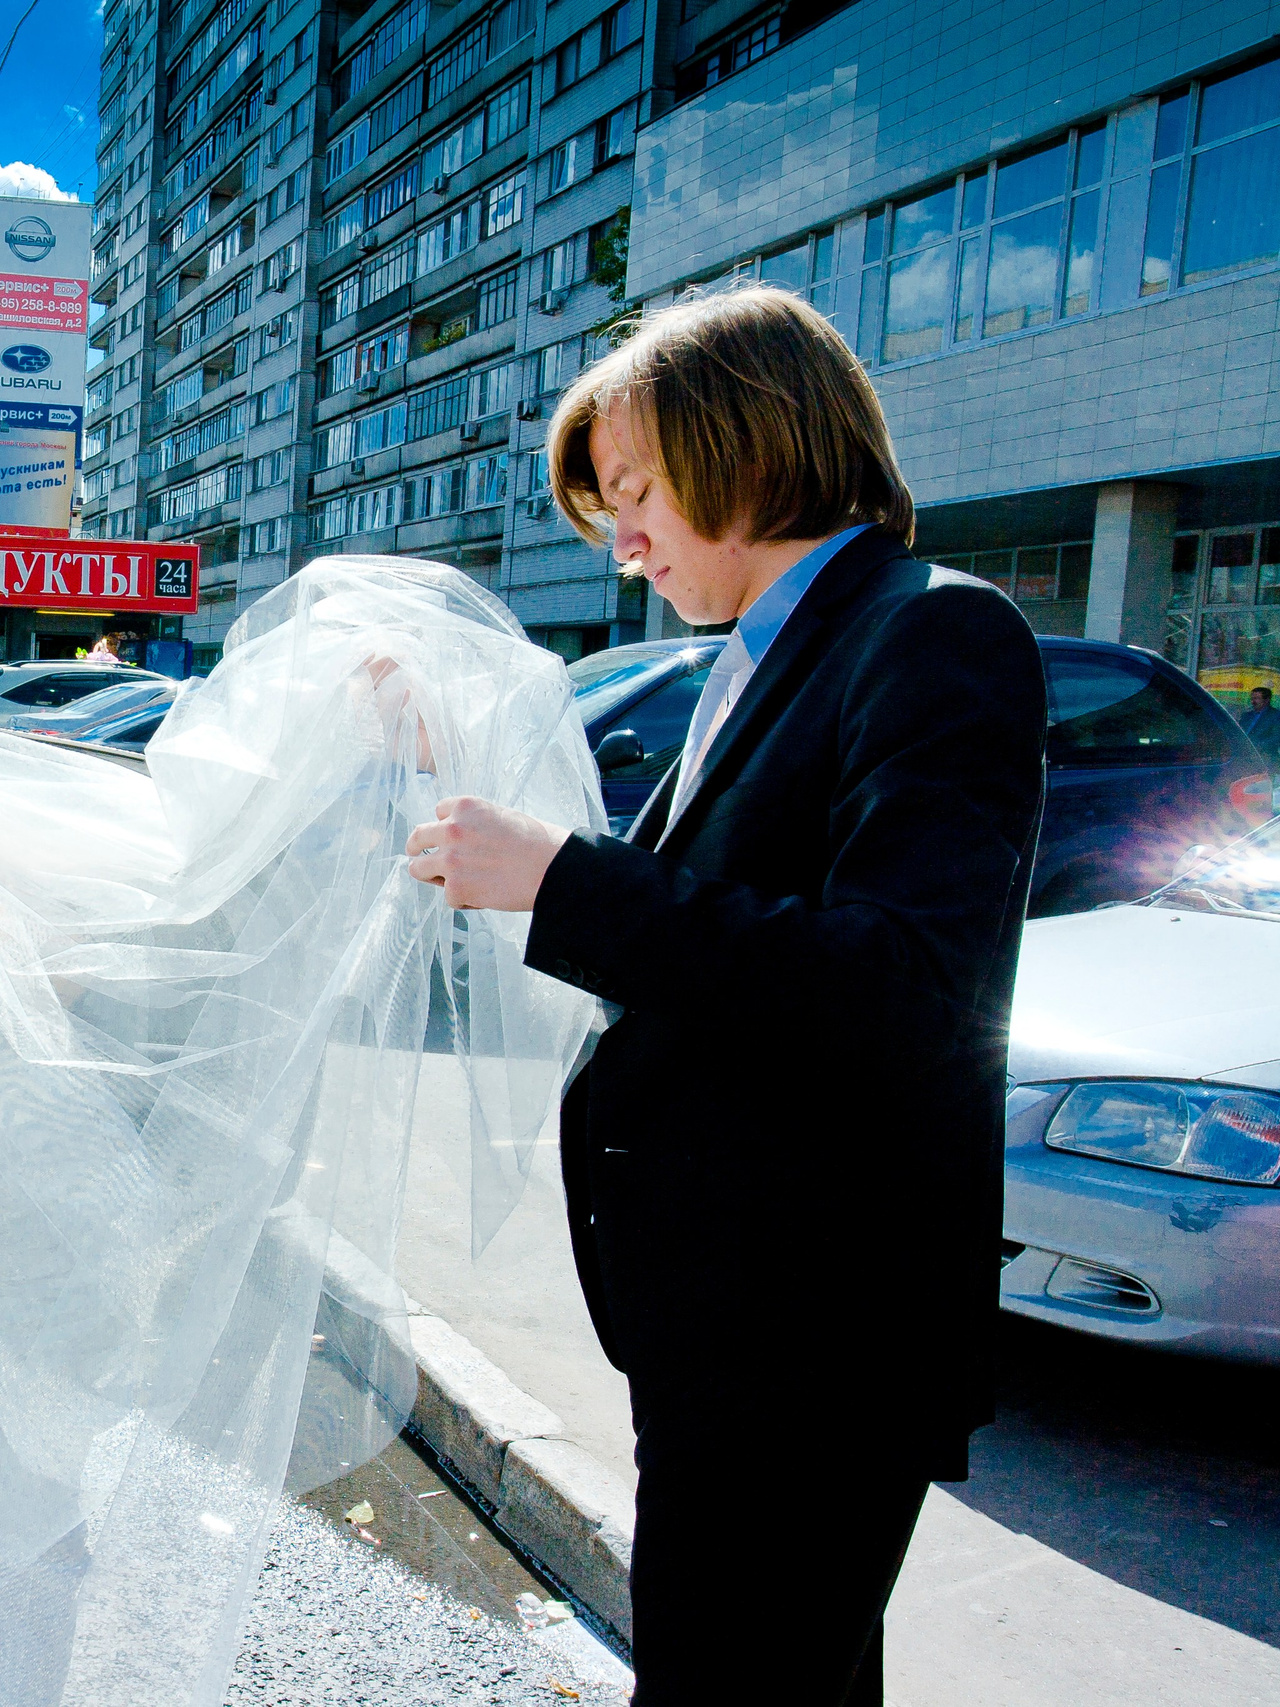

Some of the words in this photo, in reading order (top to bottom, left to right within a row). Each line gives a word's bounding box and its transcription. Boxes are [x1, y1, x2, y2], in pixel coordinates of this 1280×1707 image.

[10, 233, 52, 245] NISSAN
[56, 285, 78, 295] 200м
[21, 298, 82, 315] 258-8-989
[50, 412, 72, 421] 200м
[26, 474, 67, 490] есть!
[159, 560, 188, 583] 24
[158, 582, 187, 595] часа
